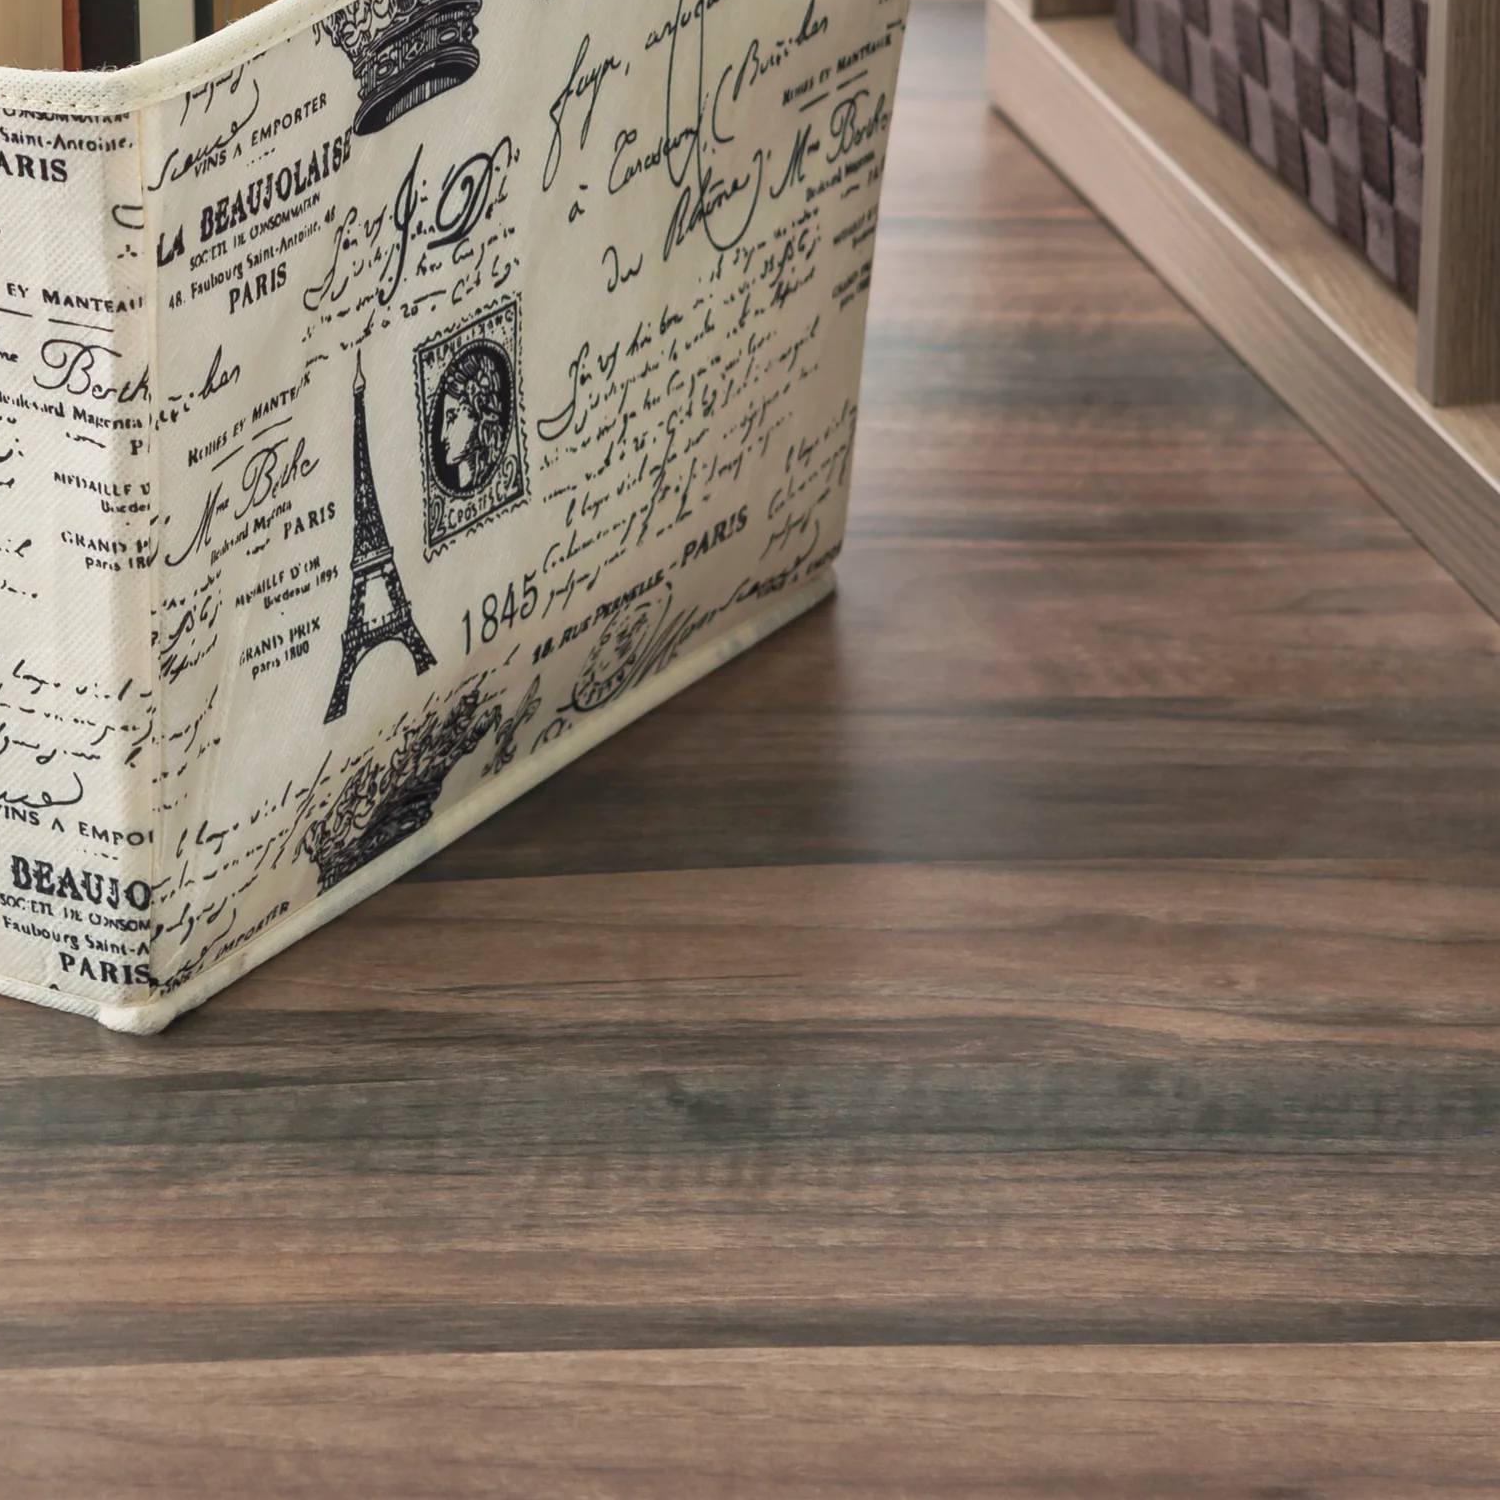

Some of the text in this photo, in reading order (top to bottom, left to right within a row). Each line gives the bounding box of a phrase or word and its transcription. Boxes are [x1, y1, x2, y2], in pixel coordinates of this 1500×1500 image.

[195, 148, 227, 177] VINS
[251, 93, 327, 147] EMPORTER
[157, 224, 185, 267] LA
[201, 126, 352, 242] BEAUJOLAISE
[191, 263, 243, 299] Faubourg
[229, 262, 287, 314] PARIS
[284, 502, 336, 540] PARIS
[680, 505, 749, 568] PARIS
[461, 570, 538, 654] 1845
[3, 915, 80, 950] Faubourg
[59, 952, 152, 984] PARIS
